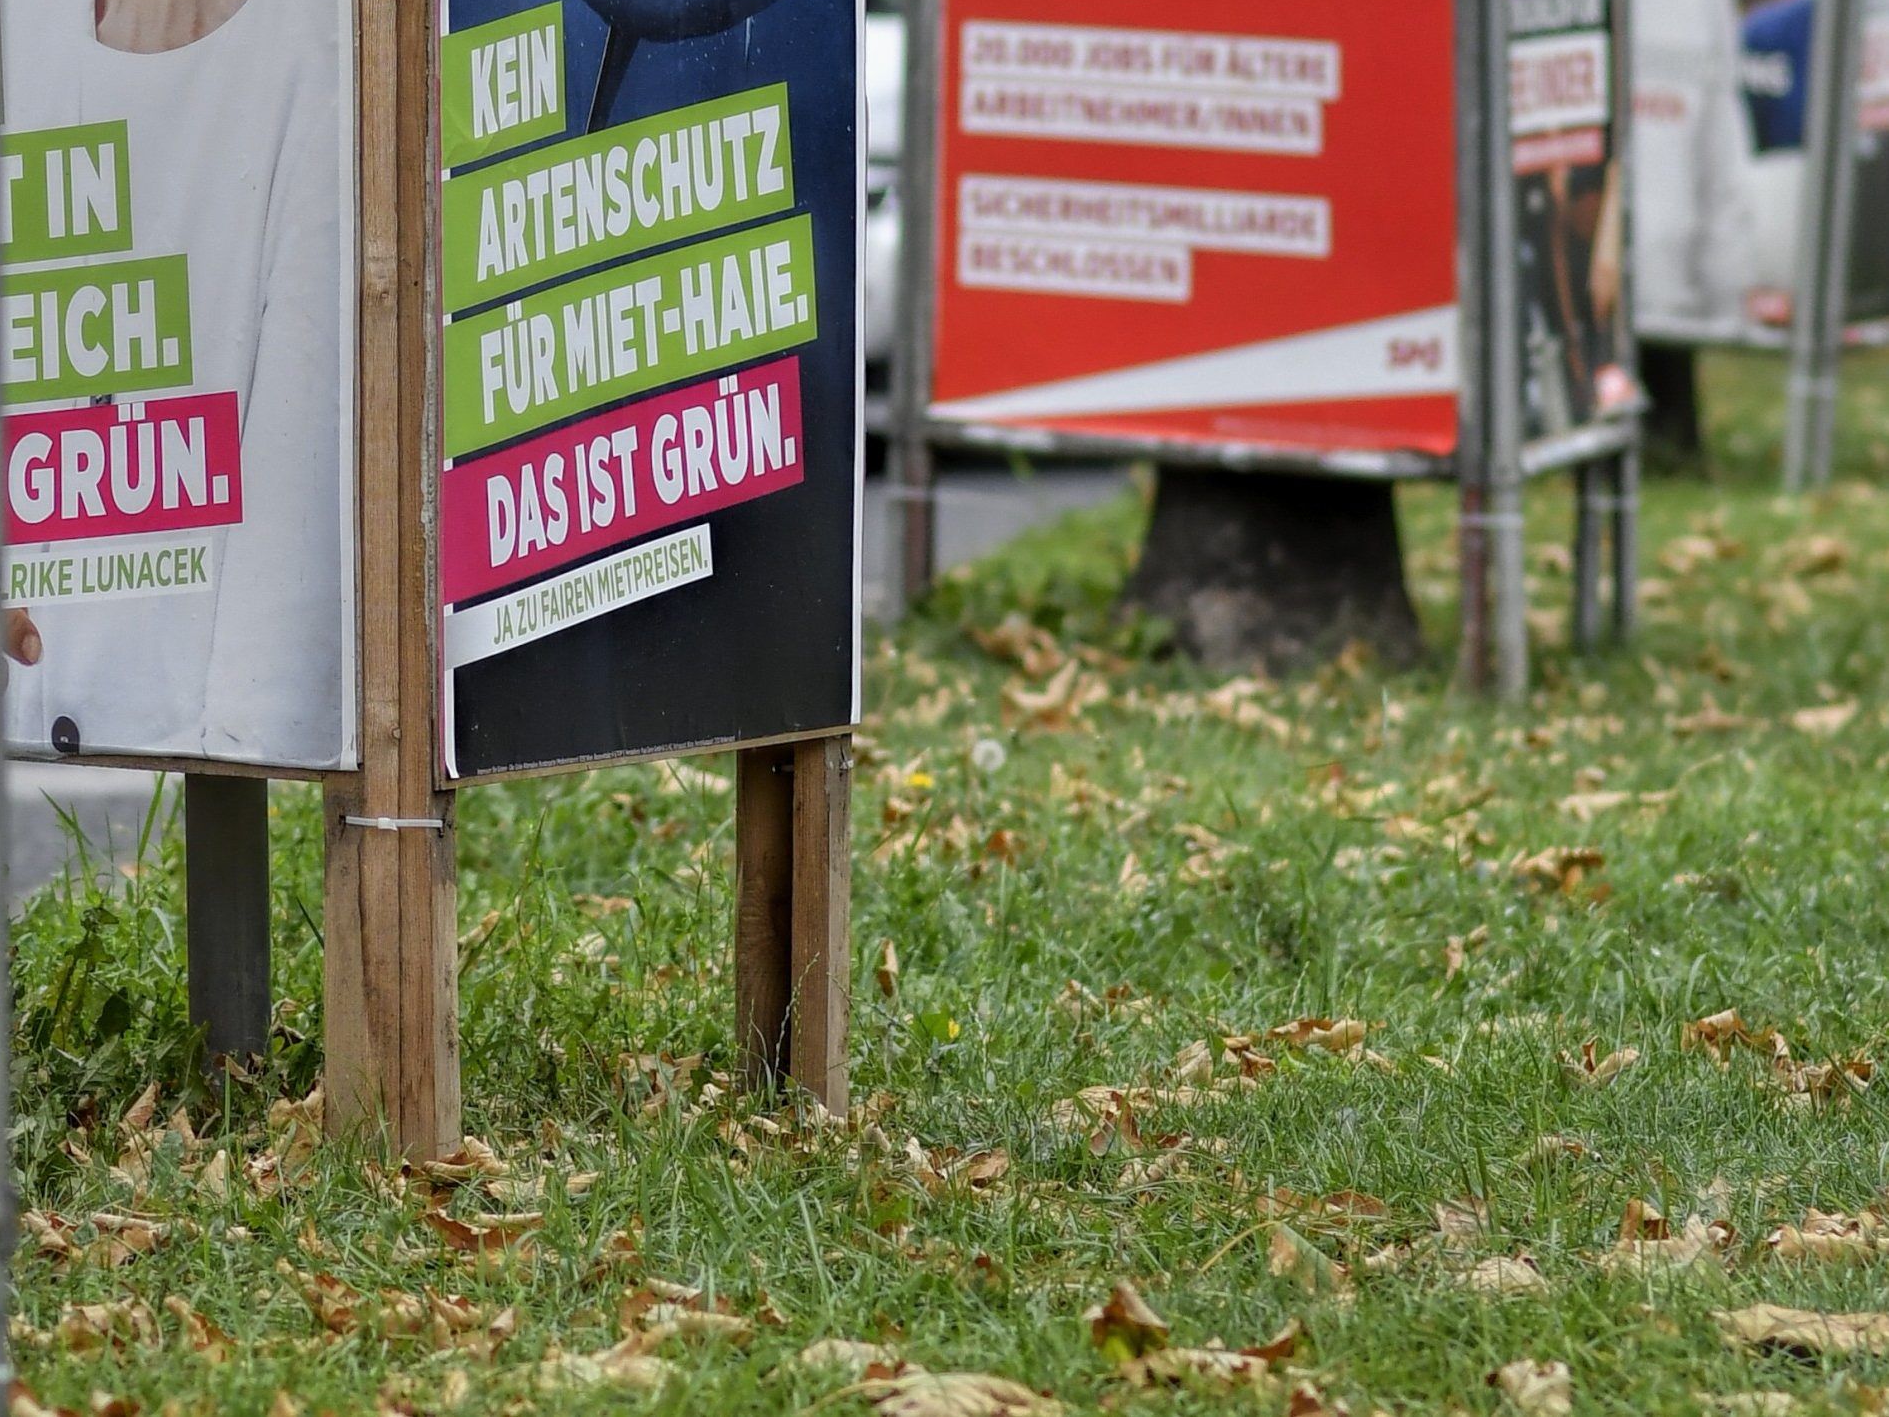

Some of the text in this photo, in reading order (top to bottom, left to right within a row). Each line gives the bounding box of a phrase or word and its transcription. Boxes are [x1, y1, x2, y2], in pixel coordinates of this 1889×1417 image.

[470, 24, 557, 140] KEIN
[45, 142, 118, 239] IN
[476, 104, 785, 282] ARTENSCHUTZ
[479, 240, 809, 425] FÜR MIET-HAIE.
[8, 403, 230, 525] GRÜN.
[486, 375, 797, 570] DAS IST GRÜN.
[0, 546, 207, 601] RIKE LUNACEK
[493, 532, 709, 646] JA ZU FAIREN MIETPREISEN.
